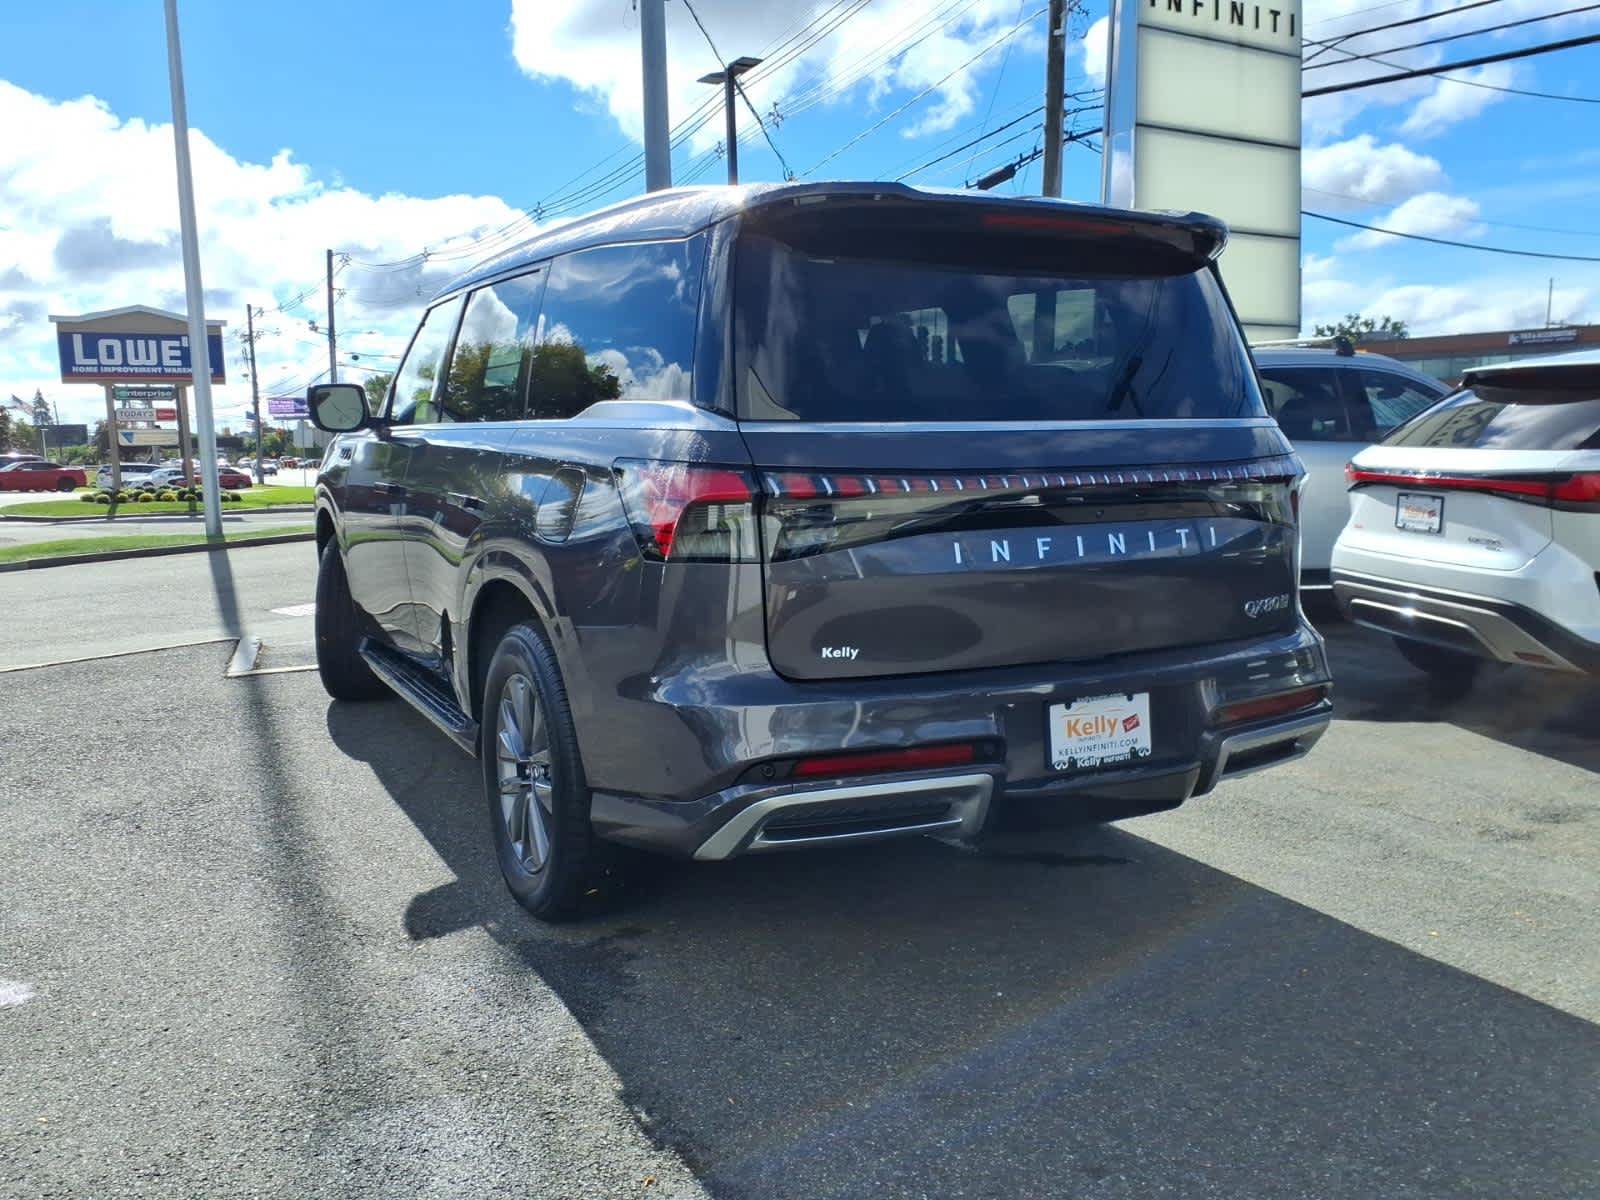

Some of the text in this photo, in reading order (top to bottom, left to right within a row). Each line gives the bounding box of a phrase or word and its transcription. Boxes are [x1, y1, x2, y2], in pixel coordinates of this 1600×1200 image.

[1150, 0, 1295, 37] NFINITI
[72, 333, 190, 367] LOWE'
[100, 366, 162, 374] IMPROVEMENT
[953, 526, 1217, 565] INFINITI
[821, 646, 859, 660] Kelly
[1066, 715, 1118, 738] Kelly
[1058, 738, 1138, 757] KELLYINFINITI.COM
[1077, 755, 1101, 768] Kelly
